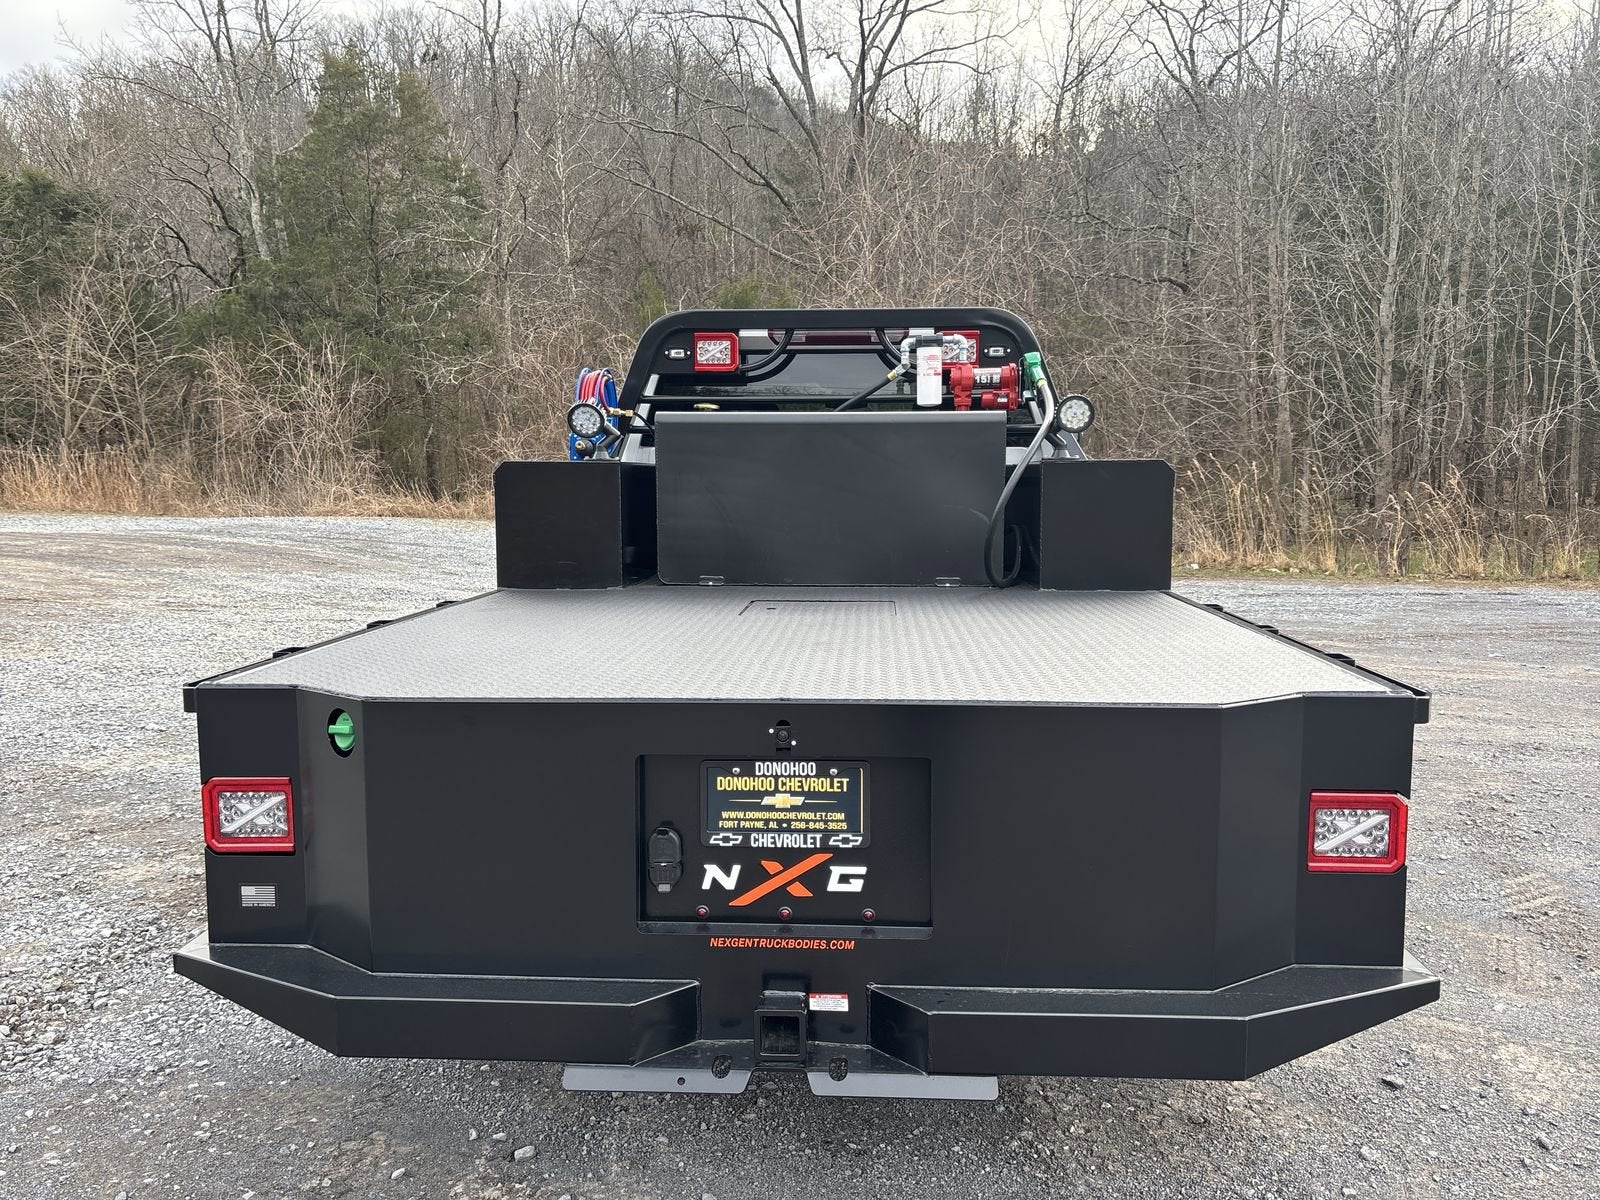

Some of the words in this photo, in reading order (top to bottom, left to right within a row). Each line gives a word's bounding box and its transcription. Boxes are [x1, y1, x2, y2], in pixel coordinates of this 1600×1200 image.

[755, 762, 816, 776] DONOHOO
[717, 777, 775, 791] DONOHOO
[778, 777, 849, 792] CHEVROLET
[721, 811, 845, 821] WWW.DONOHOOCHEVROLET.COM
[719, 820, 738, 829] FORT
[740, 820, 767, 830] PAYNE,
[768, 821, 779, 829] AL
[790, 821, 847, 830] 256-845-3525
[750, 833, 823, 848] CHEVROLET
[709, 937, 855, 950] NEXGENTRUCKBODIES.COM
